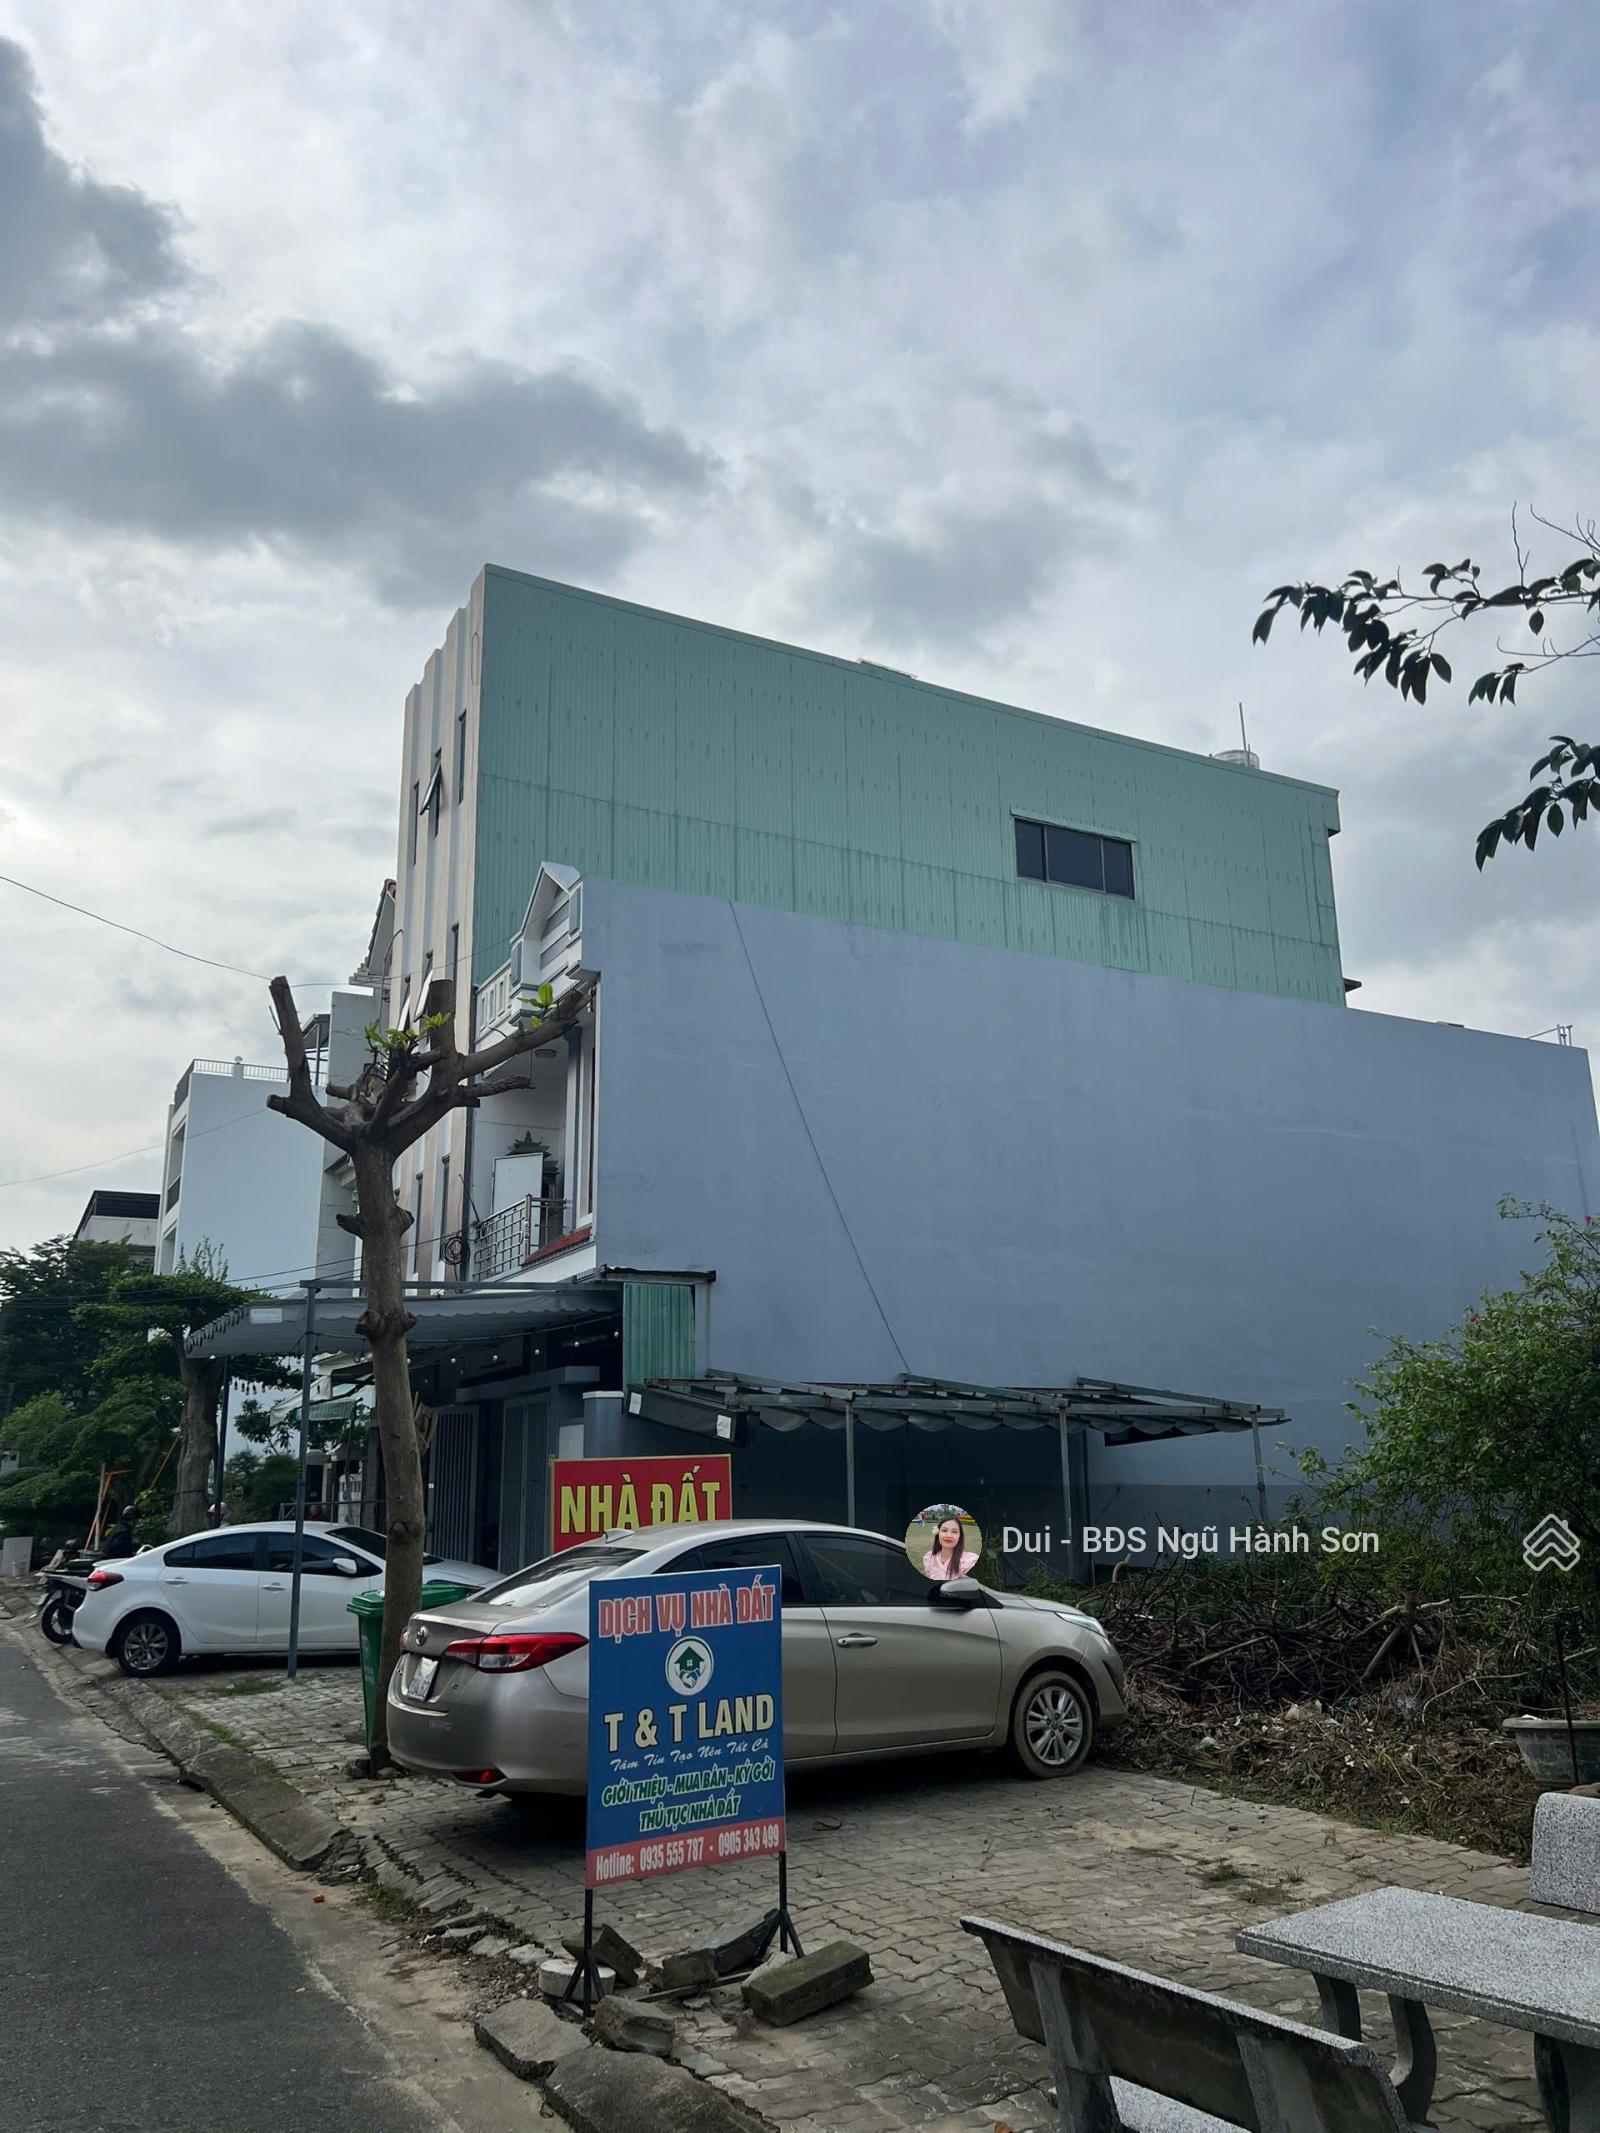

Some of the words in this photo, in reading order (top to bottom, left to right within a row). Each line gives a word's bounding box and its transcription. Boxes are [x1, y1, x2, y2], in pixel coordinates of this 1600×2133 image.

[560, 1473, 640, 1534] NHÀ
[650, 1465, 720, 1526] ĐẤT
[598, 1596, 652, 1644] DỊCH
[656, 1592, 686, 1638] VỤ
[690, 1583, 733, 1629] NHÀ
[736, 1574, 776, 1624] ĐẤT
[604, 1712, 624, 1752] T
[634, 1708, 658, 1748] &
[668, 1704, 688, 1742] T
[697, 1694, 774, 1739] LAND
[602, 1777, 633, 1807] GIỚI
[631, 1773, 668, 1804] THIỆU
[673, 1772, 703, 1795] MUA
[702, 1763, 728, 1789] BÁN
[610, 1758, 639, 1772] Tâm
[670, 1750, 693, 1764] Tạo
[697, 1745, 722, 1759] Nên
[639, 1802, 666, 1832] THỦ
[665, 1805, 690, 1832] TỤC
[688, 1794, 716, 1823] NHÀ
[715, 1787, 741, 1817] ĐẤT
[596, 1852, 634, 1881] Hotline:
[639, 1847, 664, 1872] 0935
[666, 1840, 684, 1867] 555
[687, 1837, 704, 1862] 787
[718, 1831, 741, 1857] 0905
[762, 1824, 779, 1849] 499
